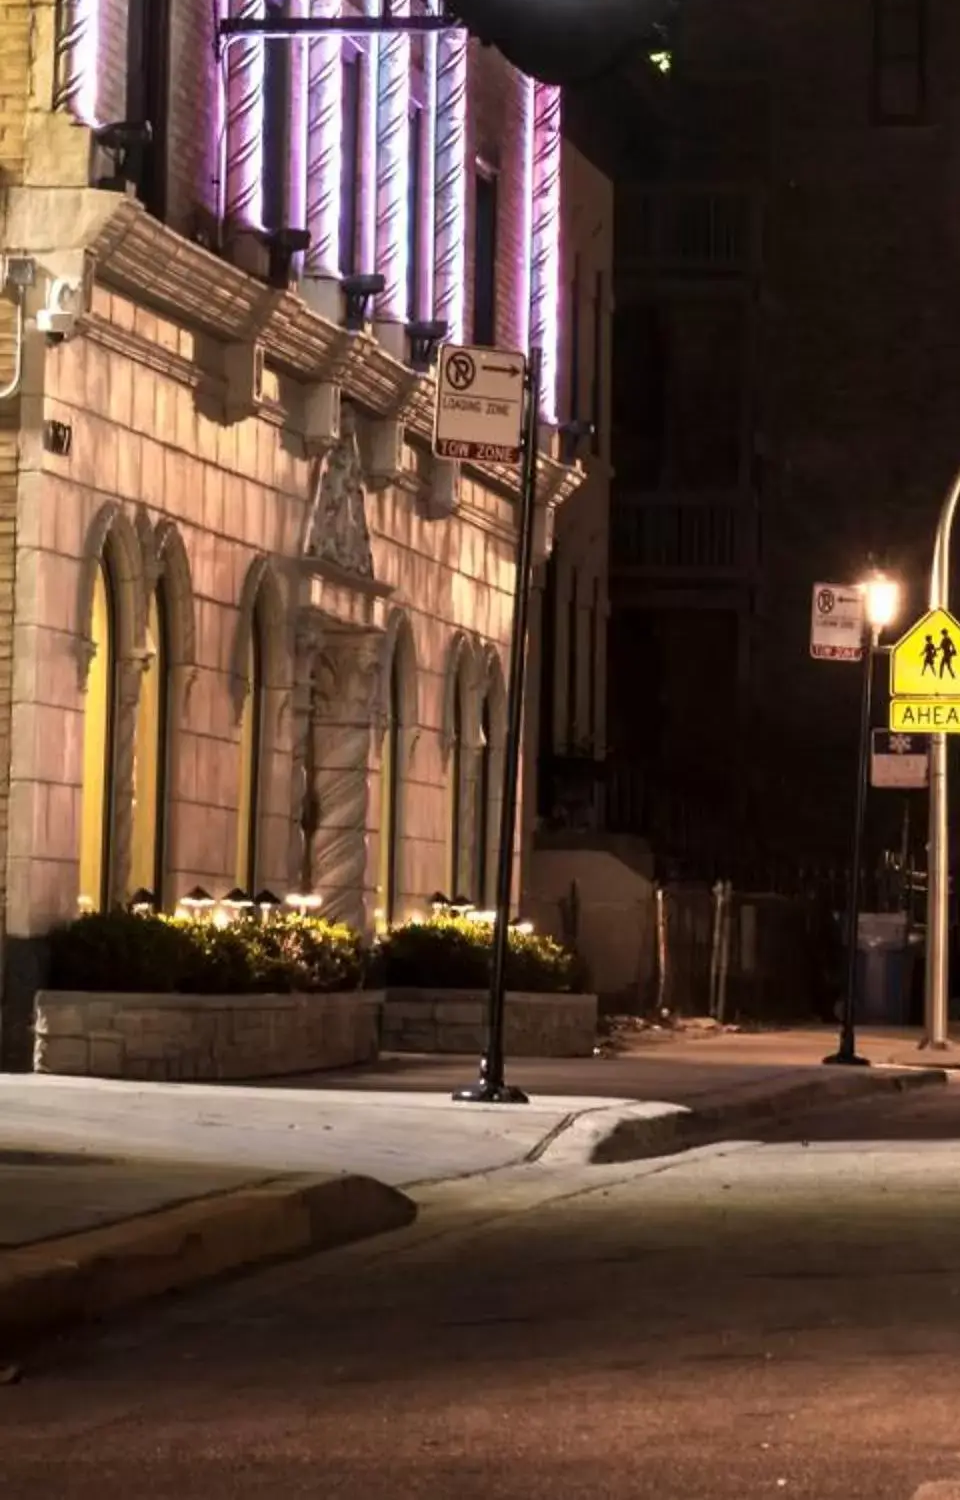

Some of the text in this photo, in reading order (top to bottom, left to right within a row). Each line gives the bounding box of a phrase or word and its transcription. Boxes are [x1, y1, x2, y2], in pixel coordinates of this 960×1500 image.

[443, 397, 510, 416] LOADING ZONE
[441, 441, 513, 461] TOW ZONE
